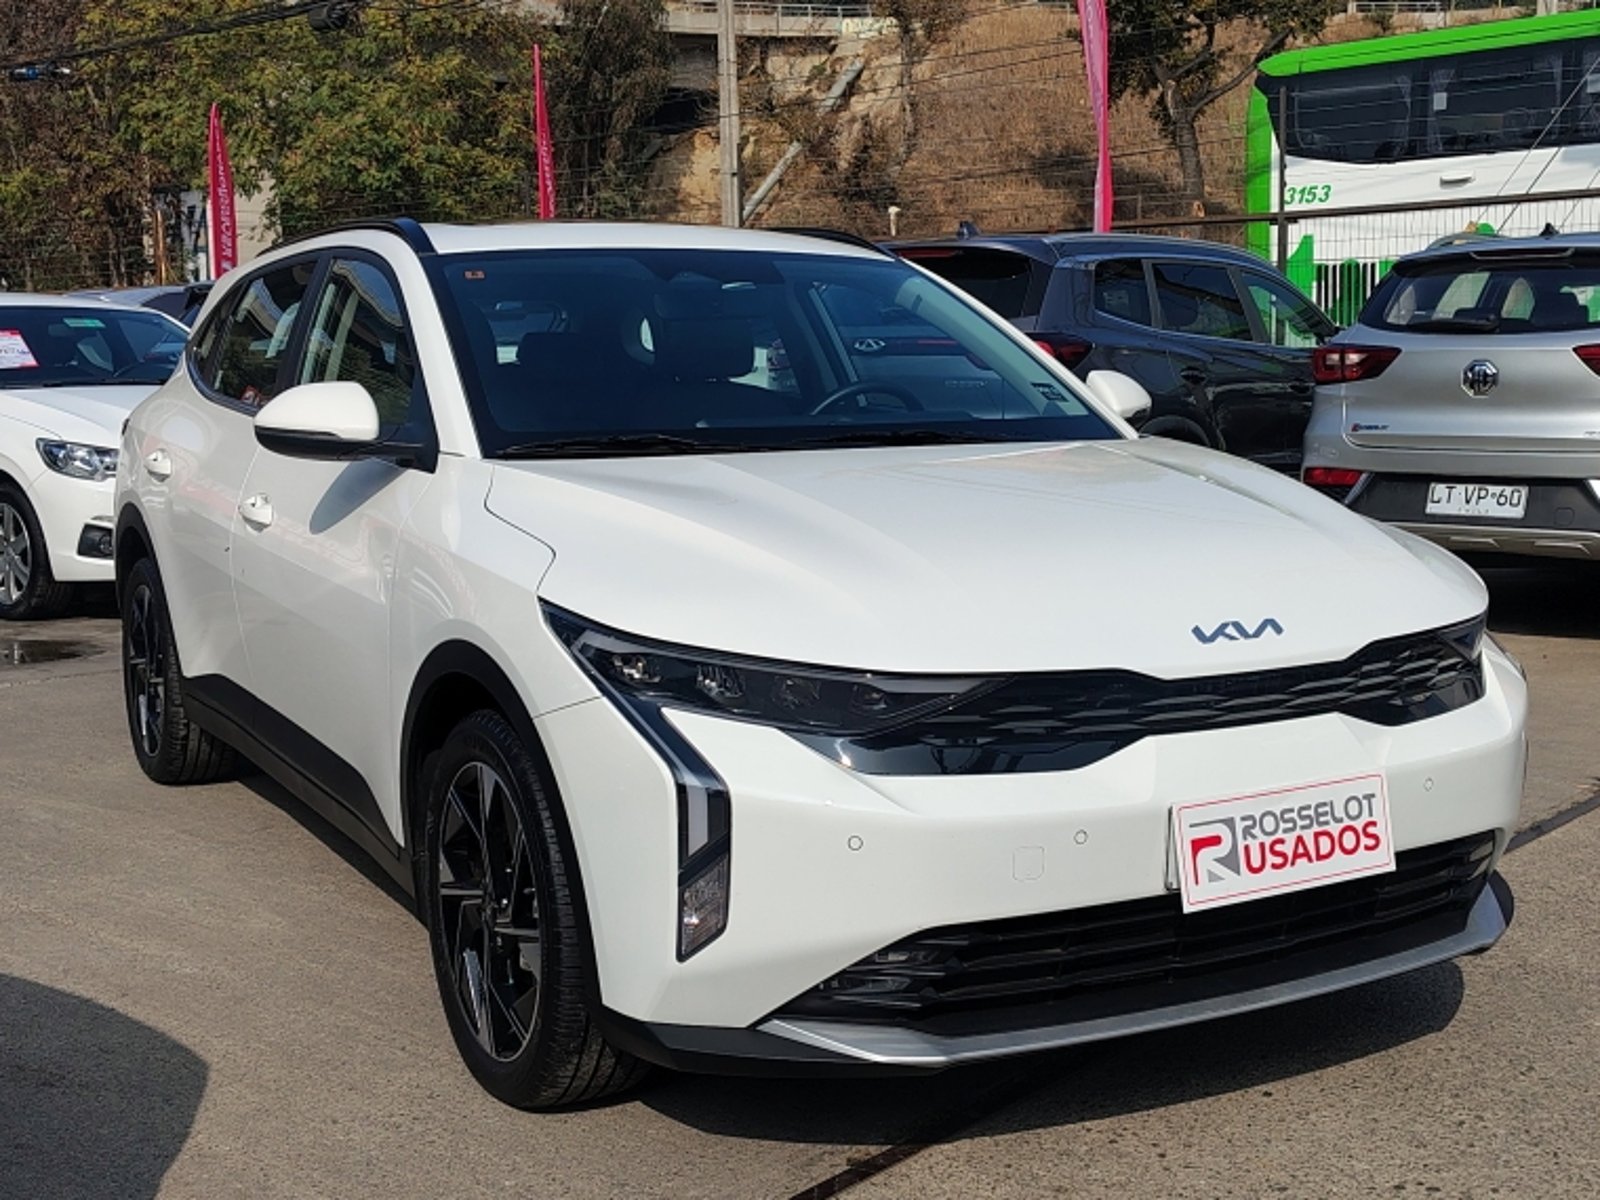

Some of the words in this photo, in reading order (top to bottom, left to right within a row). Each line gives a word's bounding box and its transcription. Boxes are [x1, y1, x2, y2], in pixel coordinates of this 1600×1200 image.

[1284, 184, 1332, 205] 3153
[1240, 793, 1376, 841] ROSSELOT
[1244, 820, 1381, 874] USADOS
